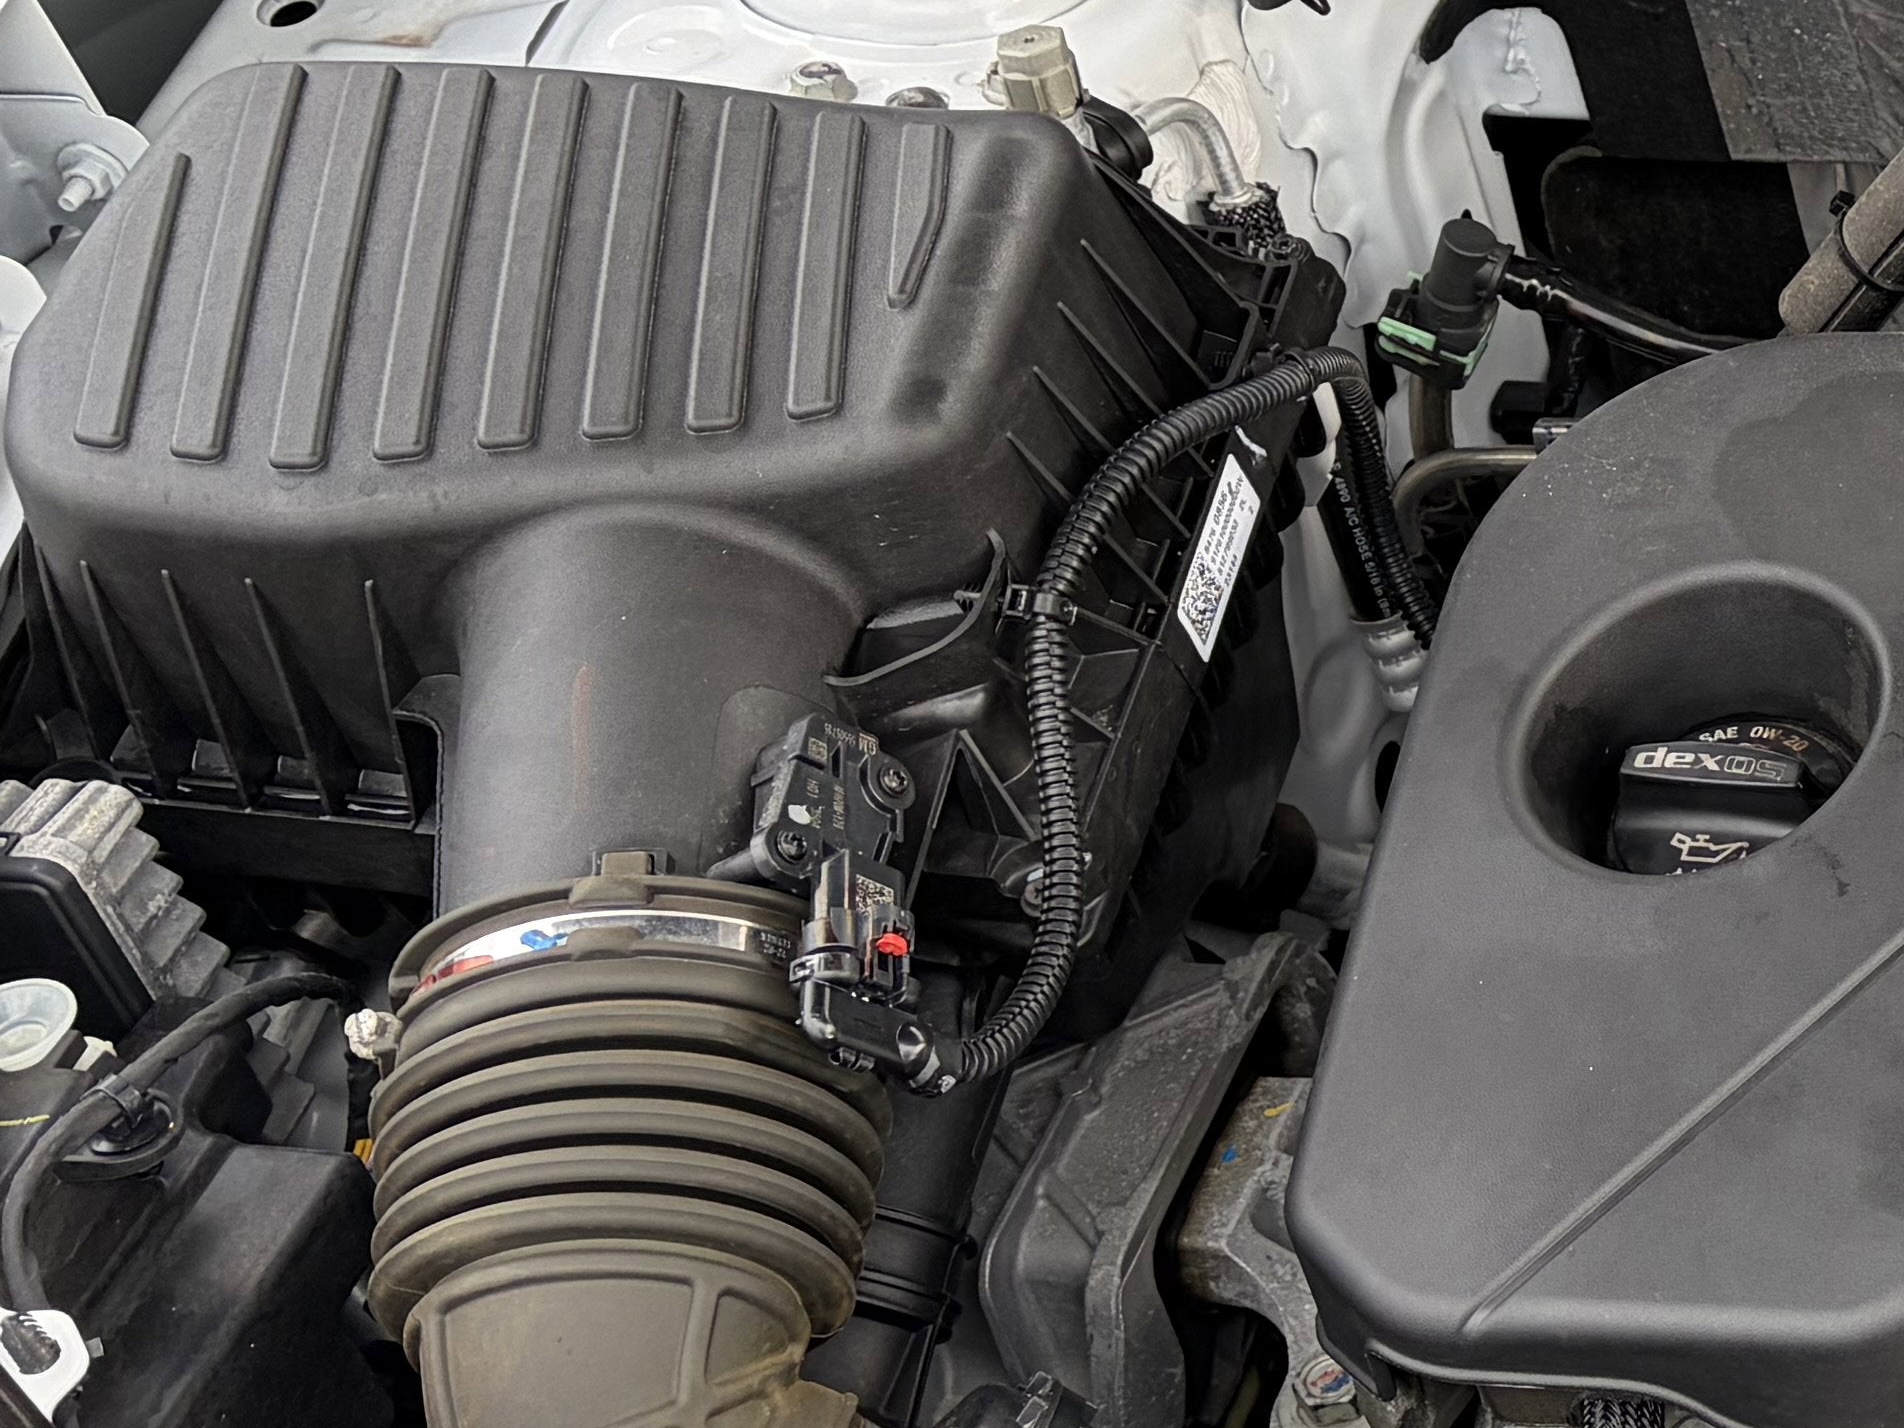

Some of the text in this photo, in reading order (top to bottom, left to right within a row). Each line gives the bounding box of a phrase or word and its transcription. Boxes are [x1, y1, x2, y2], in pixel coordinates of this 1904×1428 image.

[1343, 505, 1360, 527] A/C
[1351, 526, 1373, 561] HOSE
[1698, 725, 1811, 753] SAE 0W-20
[1633, 745, 1788, 781] dexos
